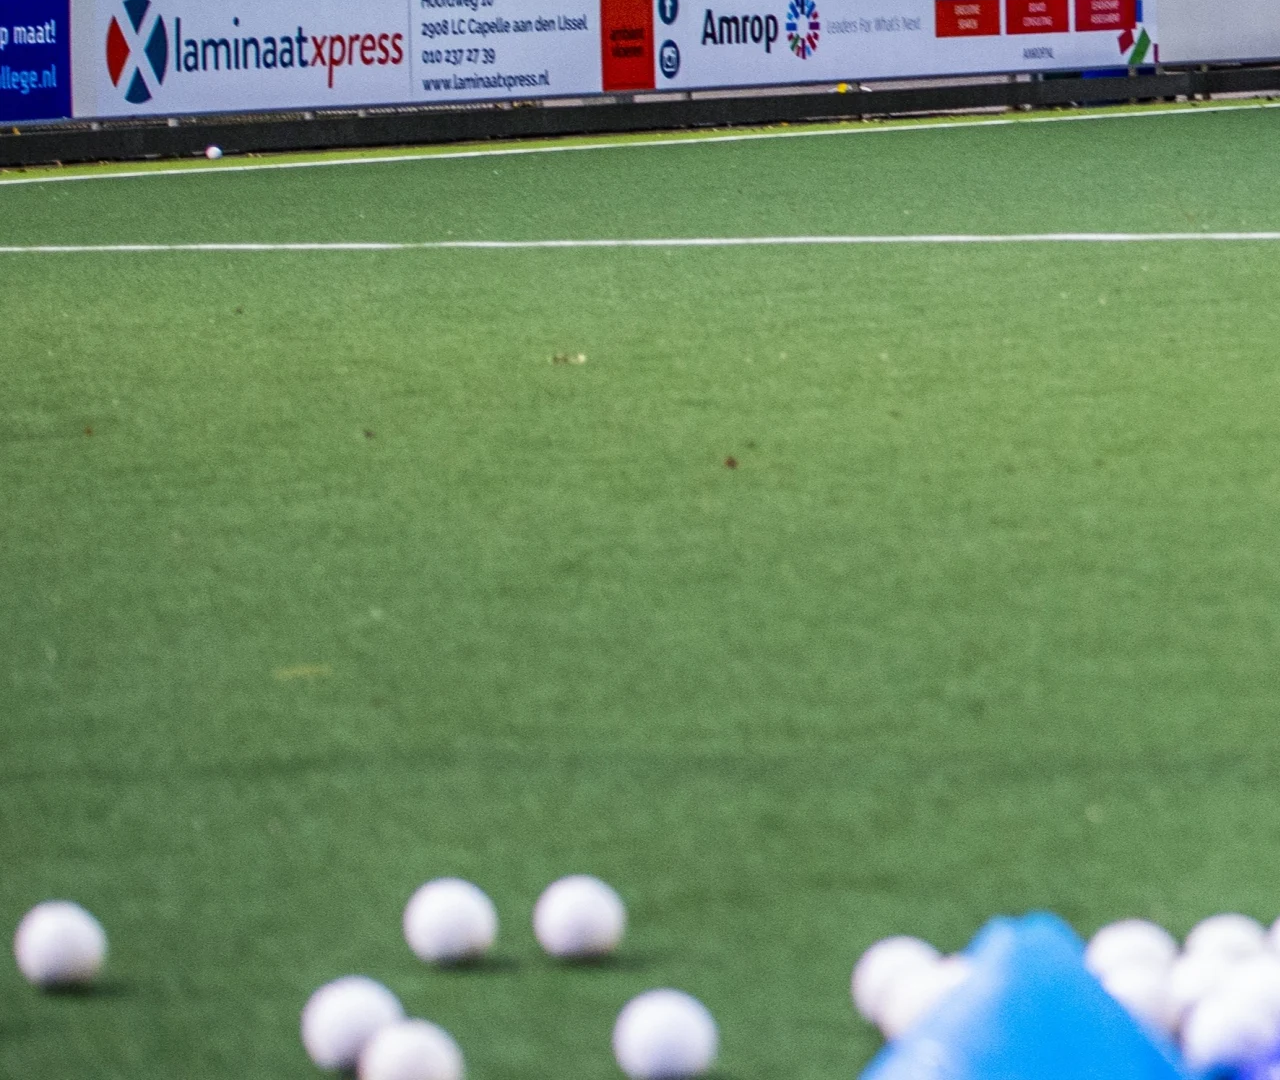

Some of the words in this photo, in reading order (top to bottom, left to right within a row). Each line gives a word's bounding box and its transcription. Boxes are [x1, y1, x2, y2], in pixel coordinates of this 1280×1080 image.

[13, 18, 57, 45] maat!
[451, 18, 466, 35] LC
[467, 16, 511, 38] Capelle
[512, 19, 534, 34] aan
[535, 14, 557, 33] den
[701, 8, 779, 54] Amrop
[174, 16, 404, 89] laminaatxpress
[421, 49, 443, 65] 010
[444, 48, 464, 66] 237
[466, 47, 480, 64] 27
[482, 47, 496, 65] 39
[0, 63, 57, 95] llege.nl
[421, 69, 550, 92] www.laminaatxpress.nl
